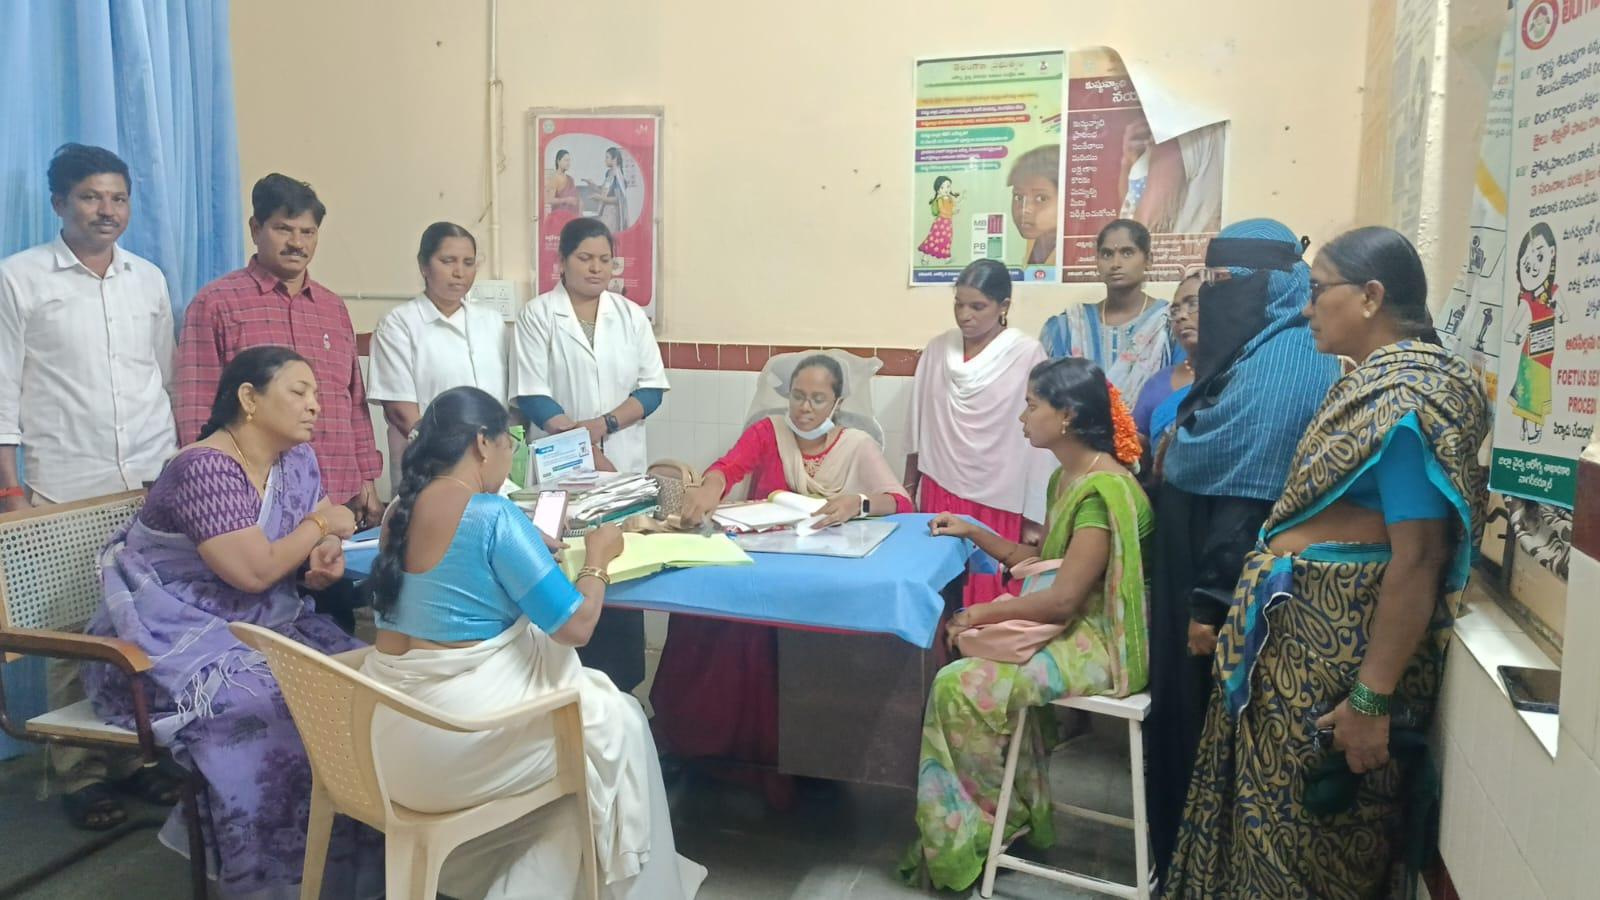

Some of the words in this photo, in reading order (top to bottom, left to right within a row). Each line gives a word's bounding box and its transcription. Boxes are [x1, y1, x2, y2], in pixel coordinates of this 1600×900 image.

[1531, 184, 1538, 197] 3
[973, 242, 986, 250] PB
[1557, 369, 1586, 386] FOETUS
